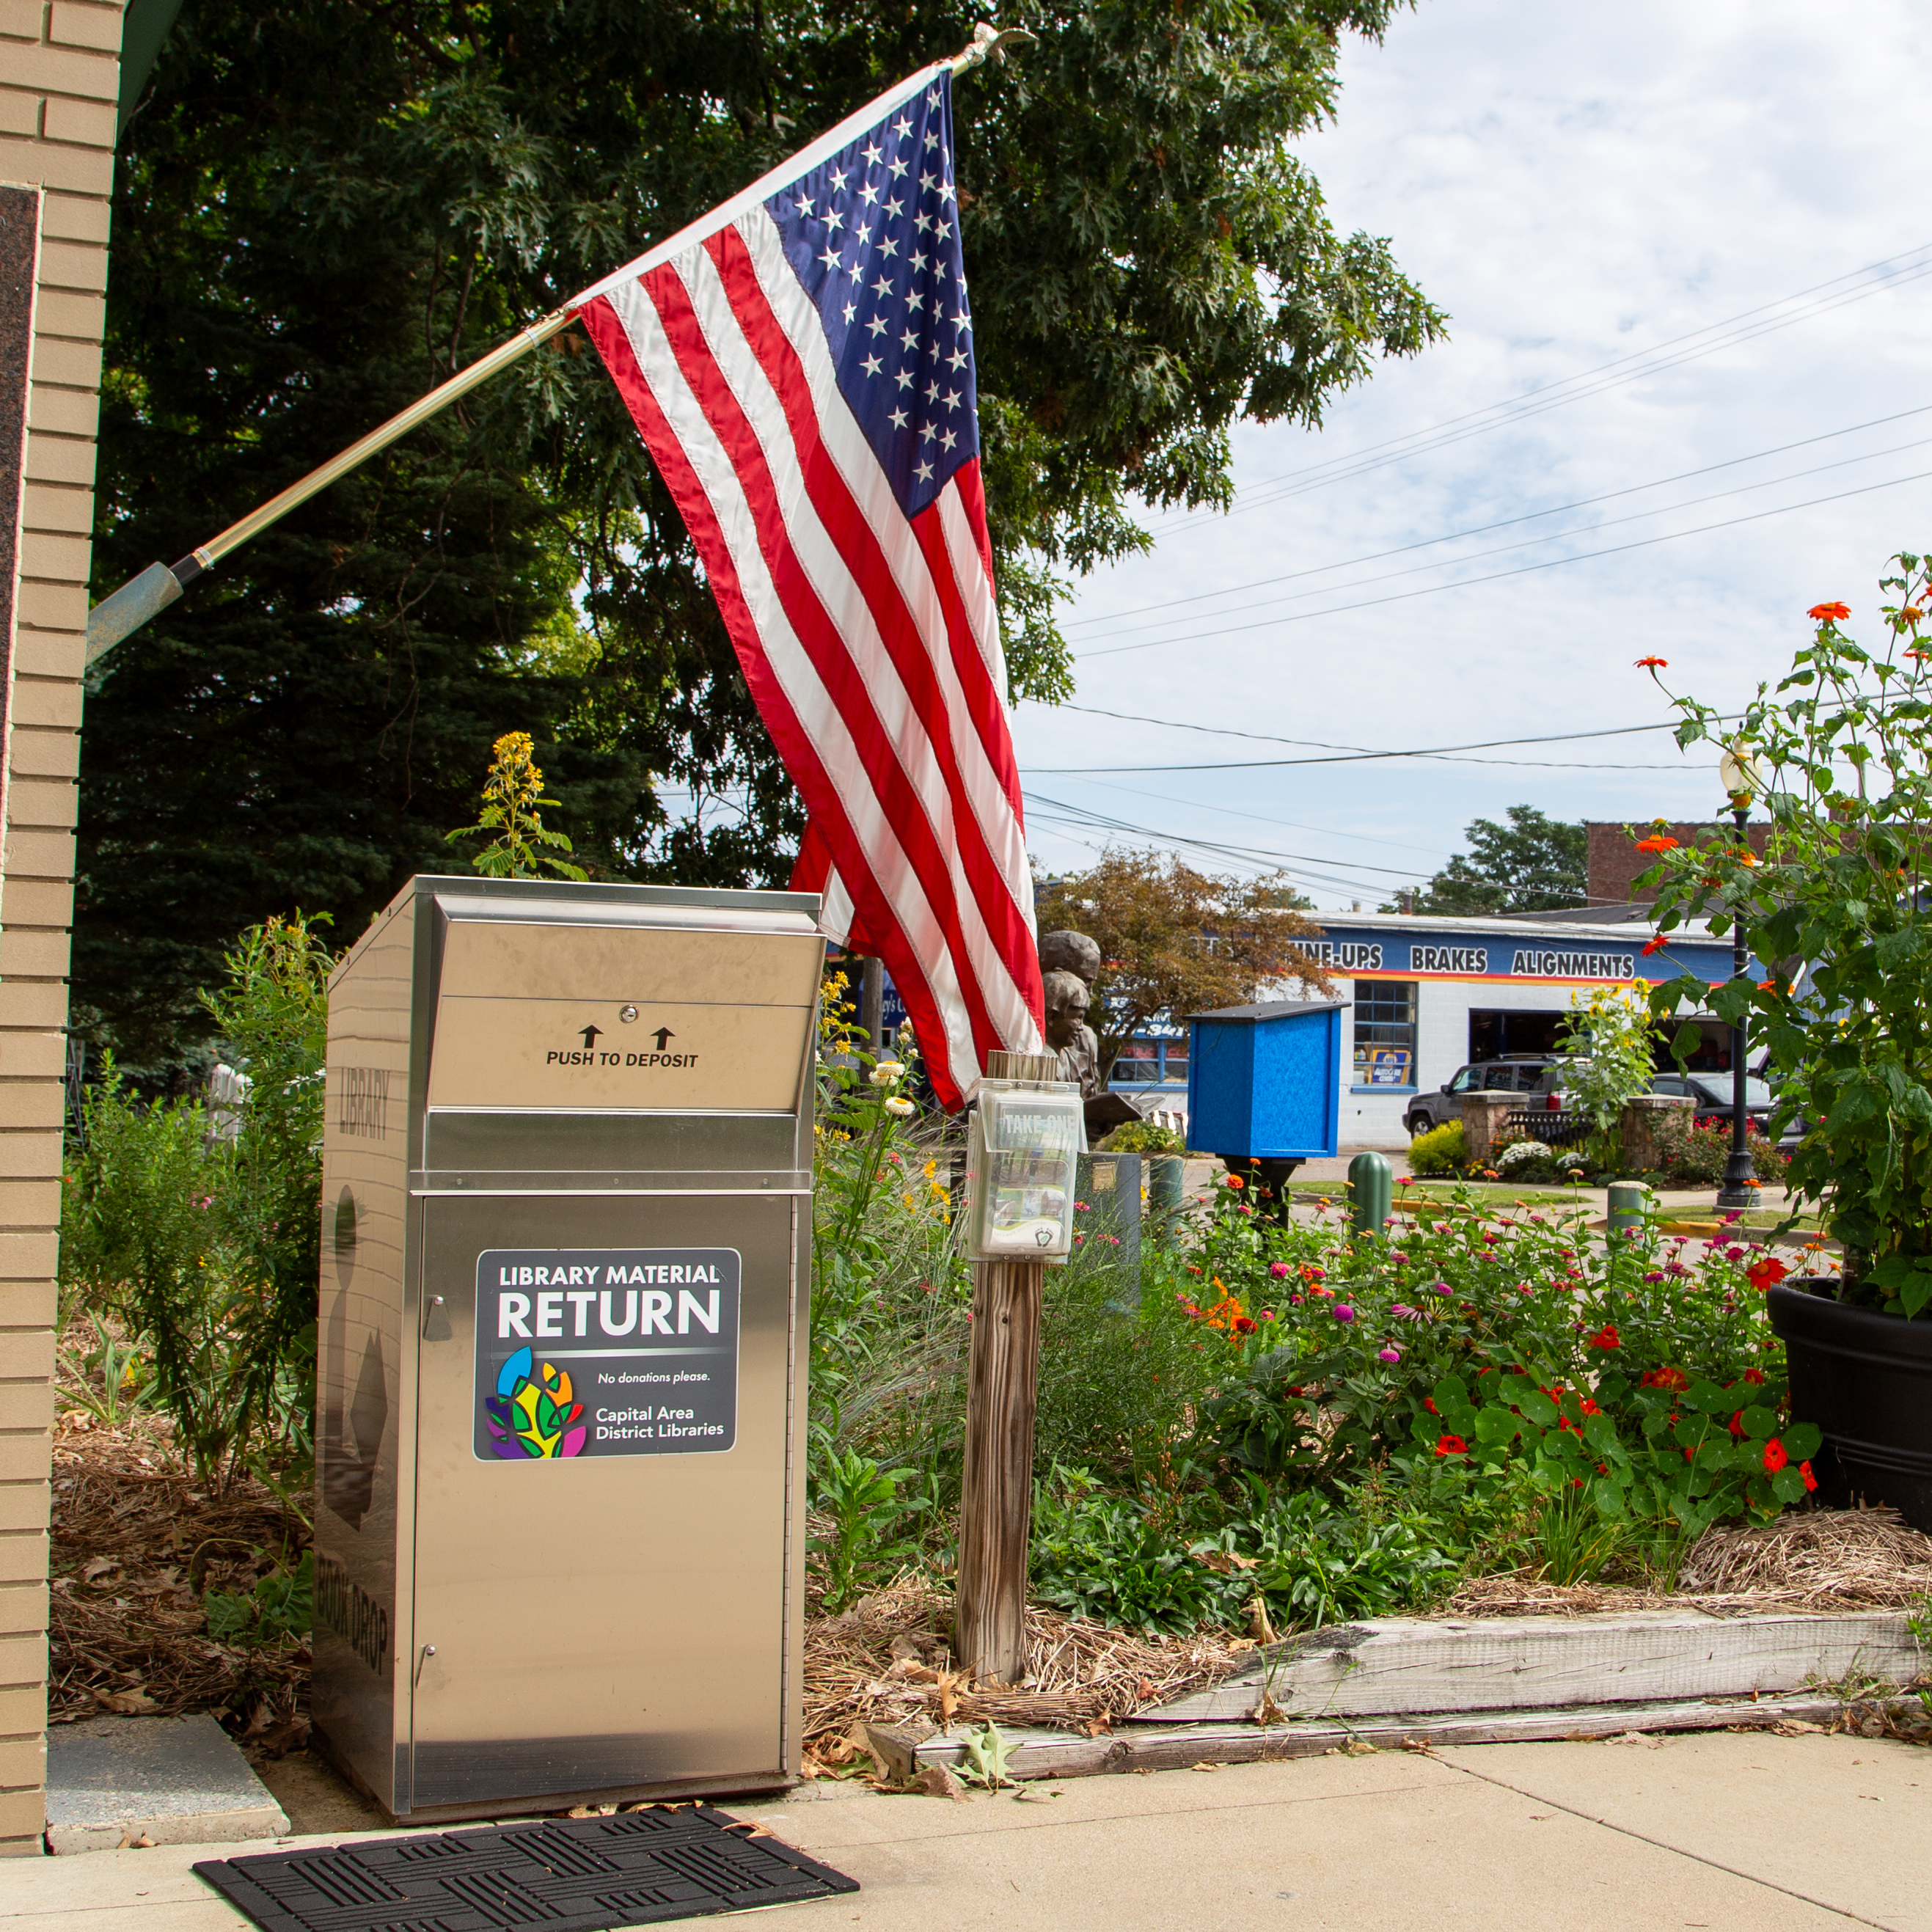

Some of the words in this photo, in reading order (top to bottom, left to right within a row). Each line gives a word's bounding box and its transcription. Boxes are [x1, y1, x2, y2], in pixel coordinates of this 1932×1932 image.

[1288, 940, 1383, 970] NE-UPS
[1410, 945, 1488, 974] BRAKES
[1511, 950, 1634, 980] ALIGNMENTS
[546, 1051, 594, 1065] PUSH
[599, 1053, 621, 1066] TO
[626, 1053, 699, 1068] DEPOSIT
[340, 1067, 390, 1141] LIBRARY
[1005, 1114, 1042, 1134] TAKE
[1047, 1114, 1075, 1134] ONE
[500, 1266, 600, 1286] LIBRARY
[605, 1265, 720, 1284] MATERIAL
[498, 1289, 720, 1339] RETURN
[598, 1373, 615, 1384] No
[618, 1371, 670, 1383] donations
[673, 1370, 711, 1385] please.
[596, 1406, 652, 1424] Capital
[656, 1406, 694, 1421] Area
[596, 1424, 654, 1440] District
[658, 1423, 724, 1438] Libraries
[352, 1583, 387, 1677] DROP
